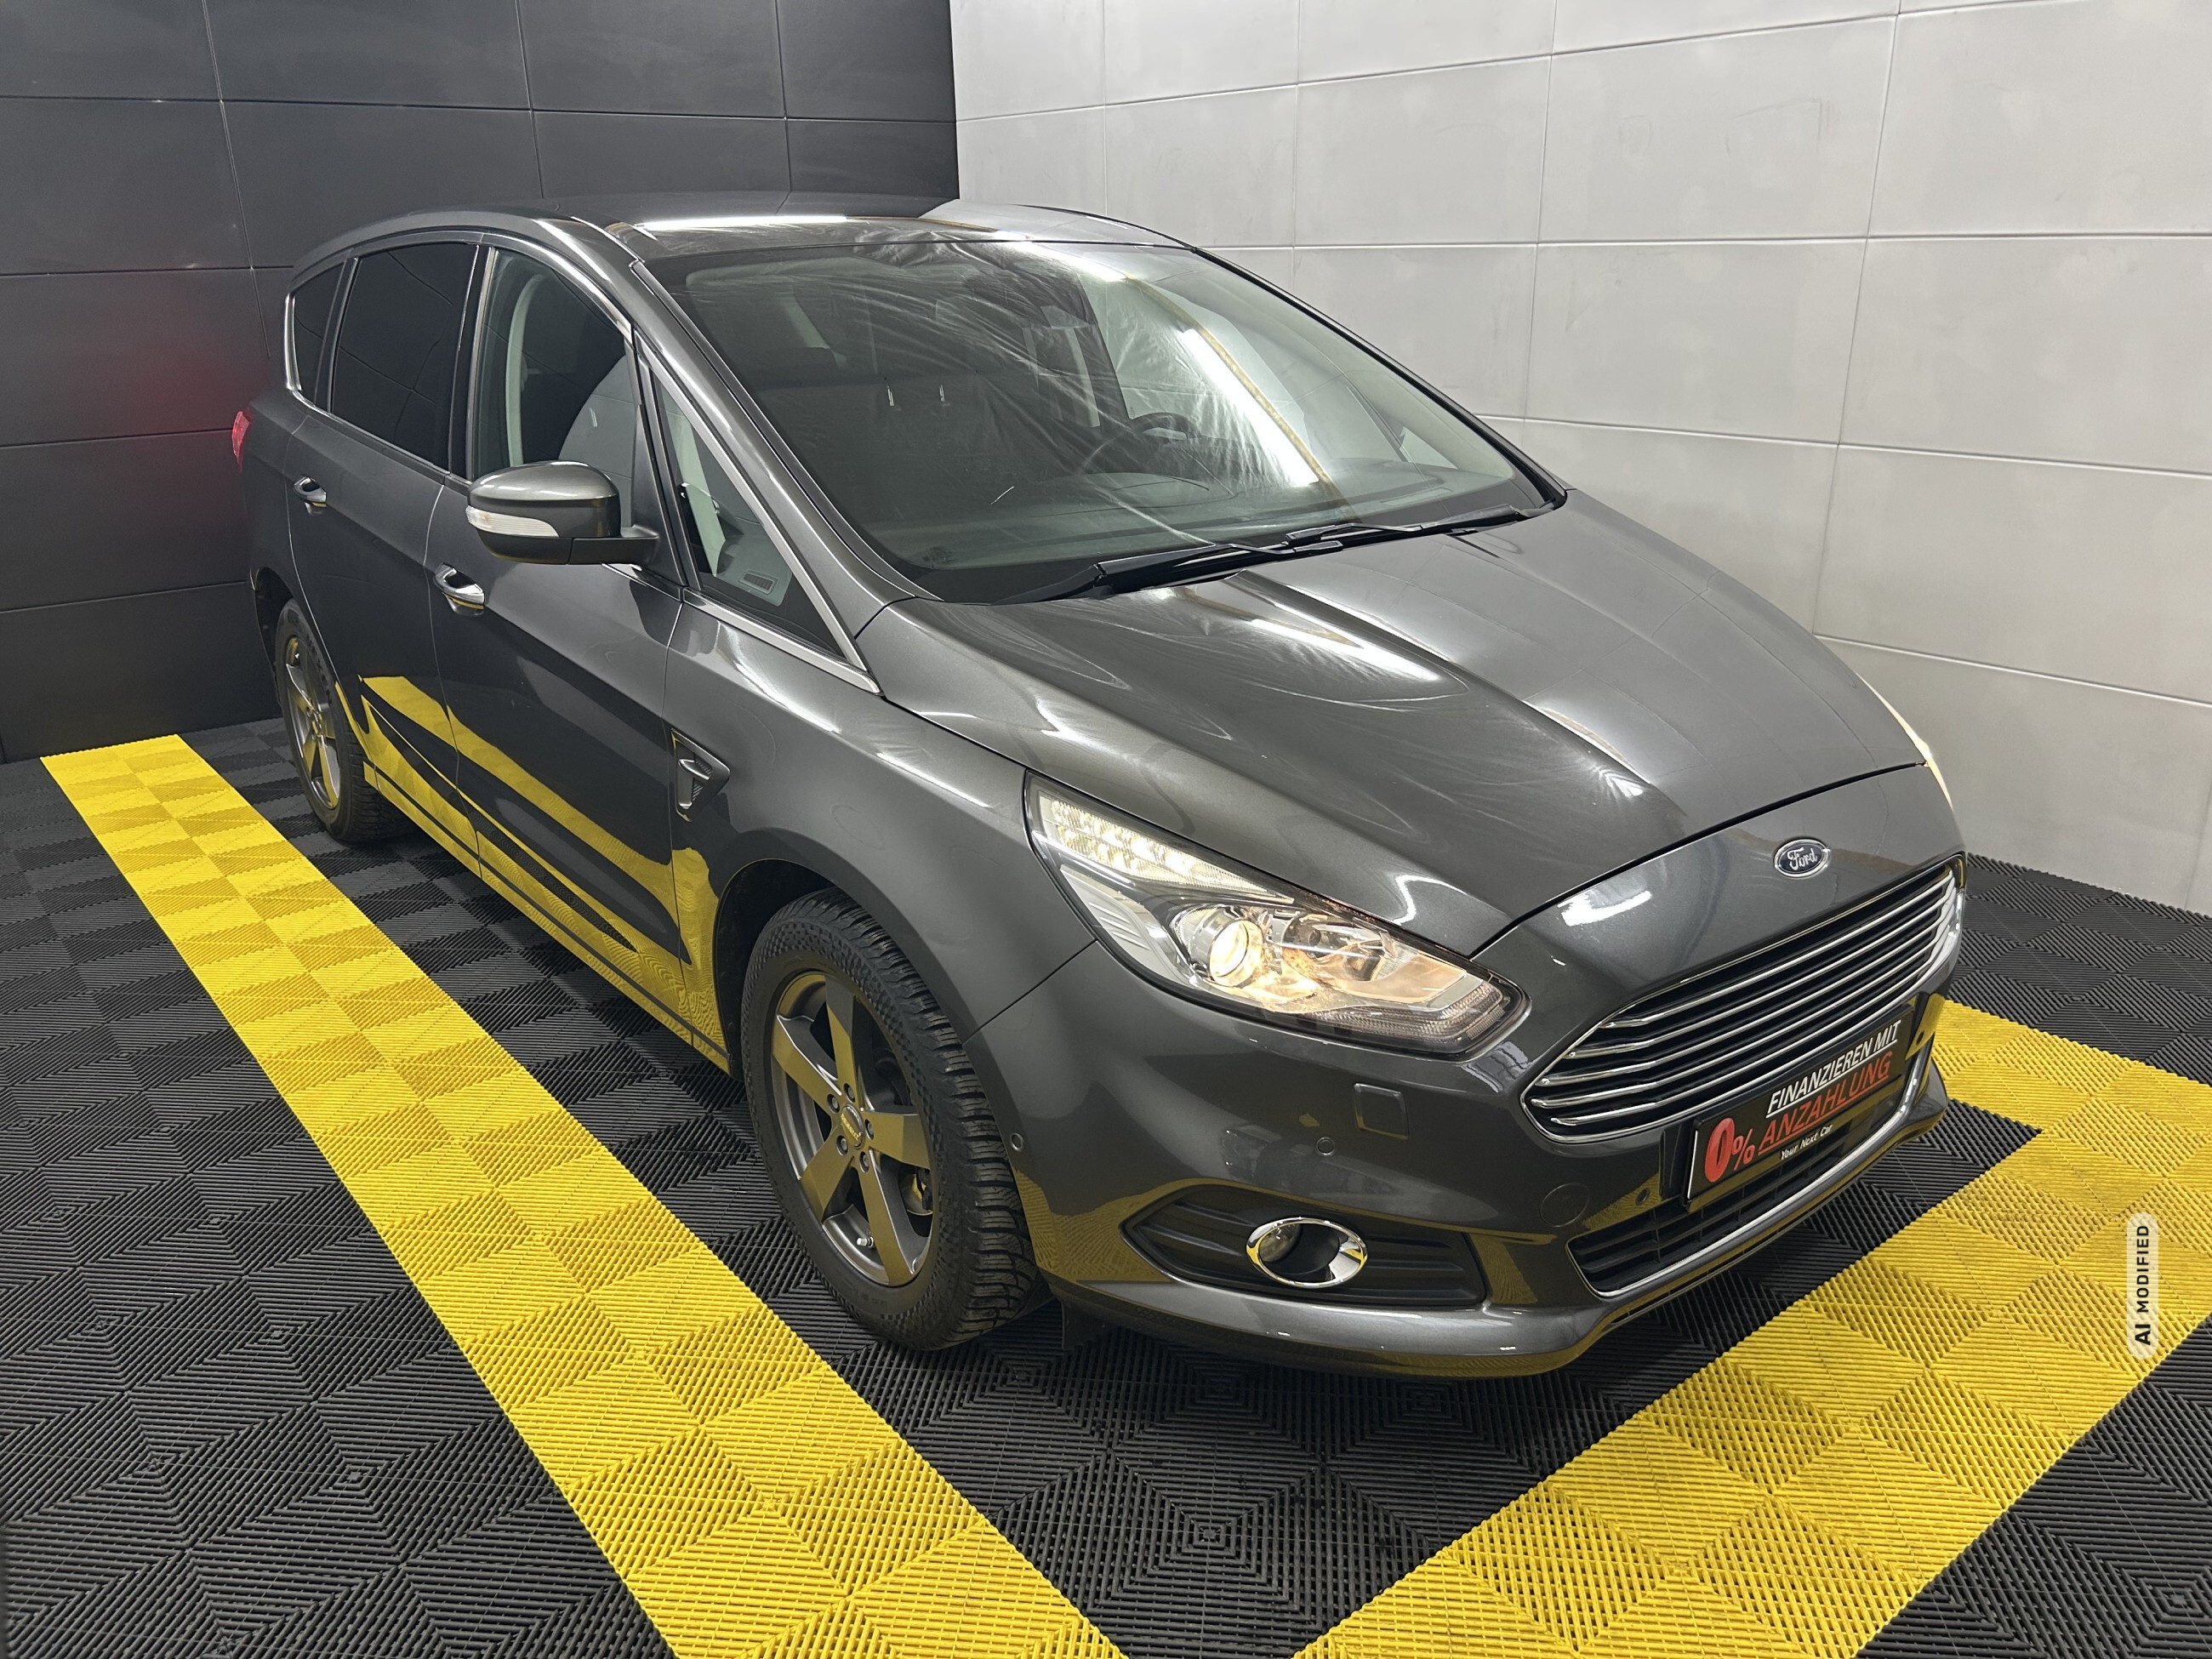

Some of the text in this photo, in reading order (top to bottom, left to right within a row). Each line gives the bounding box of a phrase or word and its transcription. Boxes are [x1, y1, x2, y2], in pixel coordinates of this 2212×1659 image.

[1787, 847, 1818, 870] Ford
[1767, 1019, 1901, 1115] FINANZIEREN MIT
[1704, 1051, 1893, 1183] 0% ANZAHLUNG
[1781, 1124, 1833, 1160] Your Next Car
